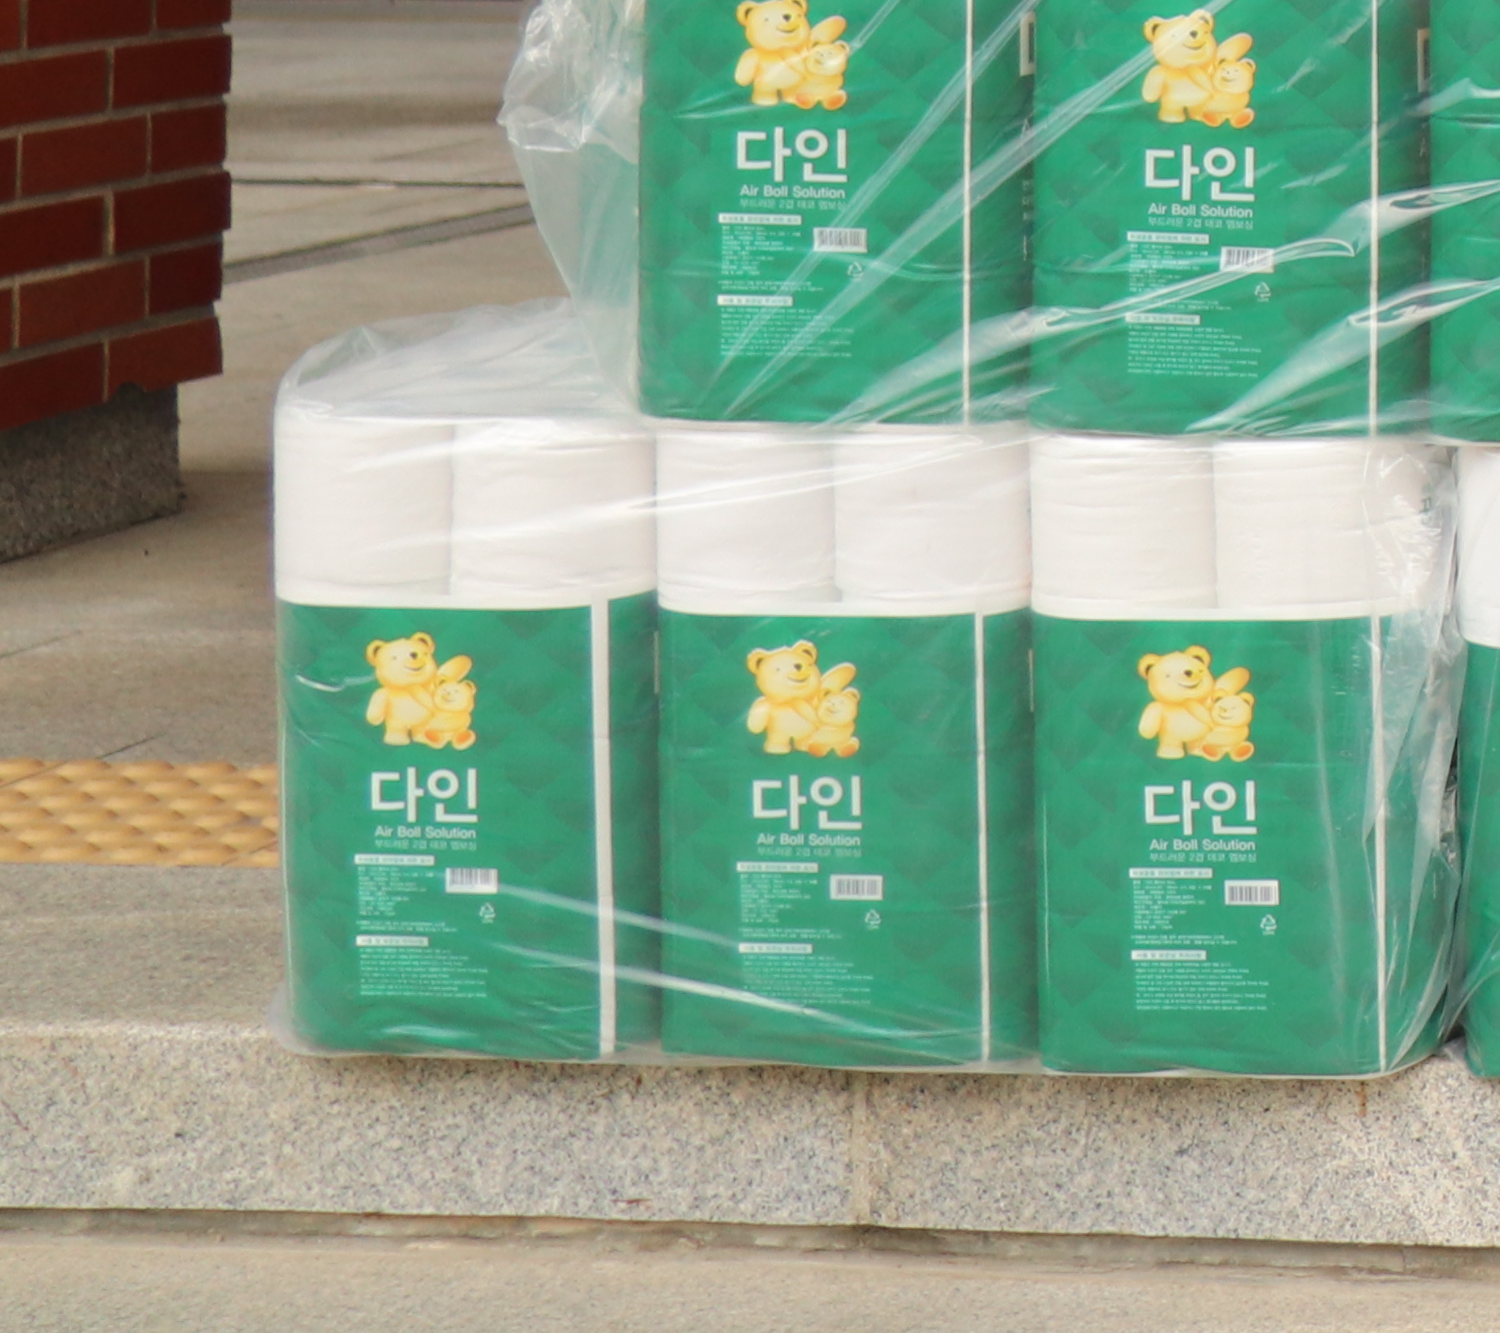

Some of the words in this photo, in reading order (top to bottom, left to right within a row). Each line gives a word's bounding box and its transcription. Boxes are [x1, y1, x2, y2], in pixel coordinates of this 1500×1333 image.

[736, 126, 848, 183] 다인
[1145, 144, 1256, 202] 다인
[371, 766, 478, 823] 다인
[752, 775, 862, 831] 다인
[1144, 779, 1258, 836] 다인
